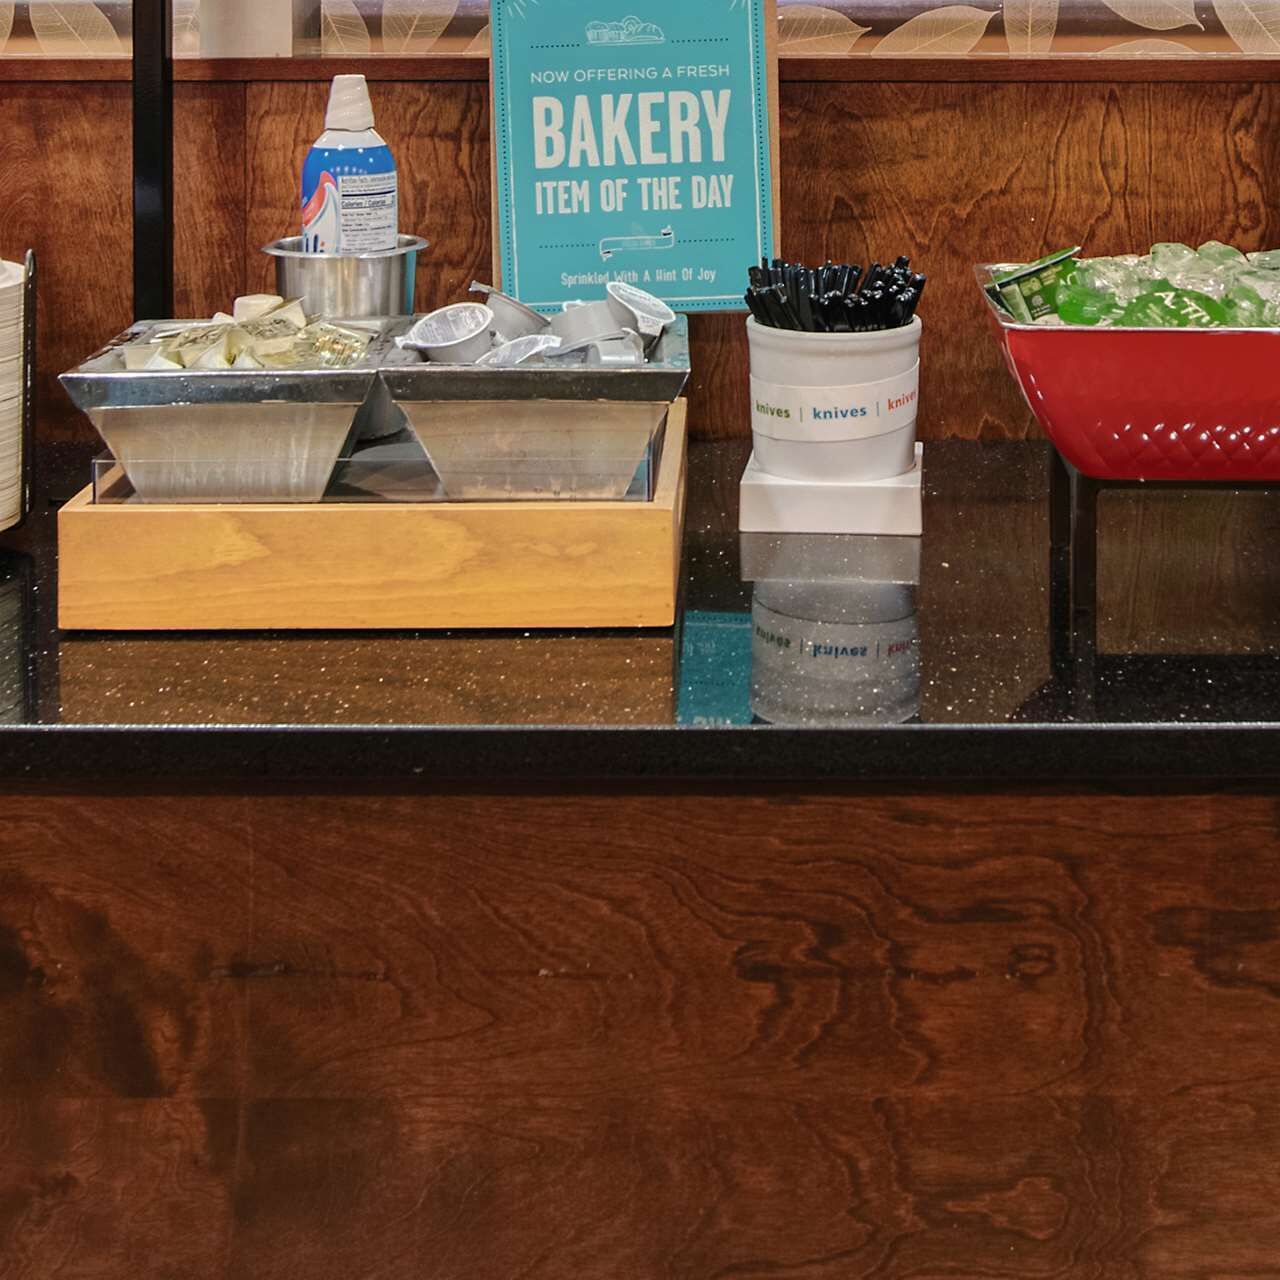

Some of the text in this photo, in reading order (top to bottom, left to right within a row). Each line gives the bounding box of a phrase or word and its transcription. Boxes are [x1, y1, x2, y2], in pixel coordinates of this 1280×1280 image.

[530, 64, 731, 84] NOW OFFERING A FRESH
[532, 88, 732, 169] BAKERY
[535, 174, 734, 215] ITEM OF THE DAY
[560, 267, 717, 288] Sprinkled With A Hint Of Joy
[756, 399, 791, 419] knives
[812, 406, 868, 420] knives
